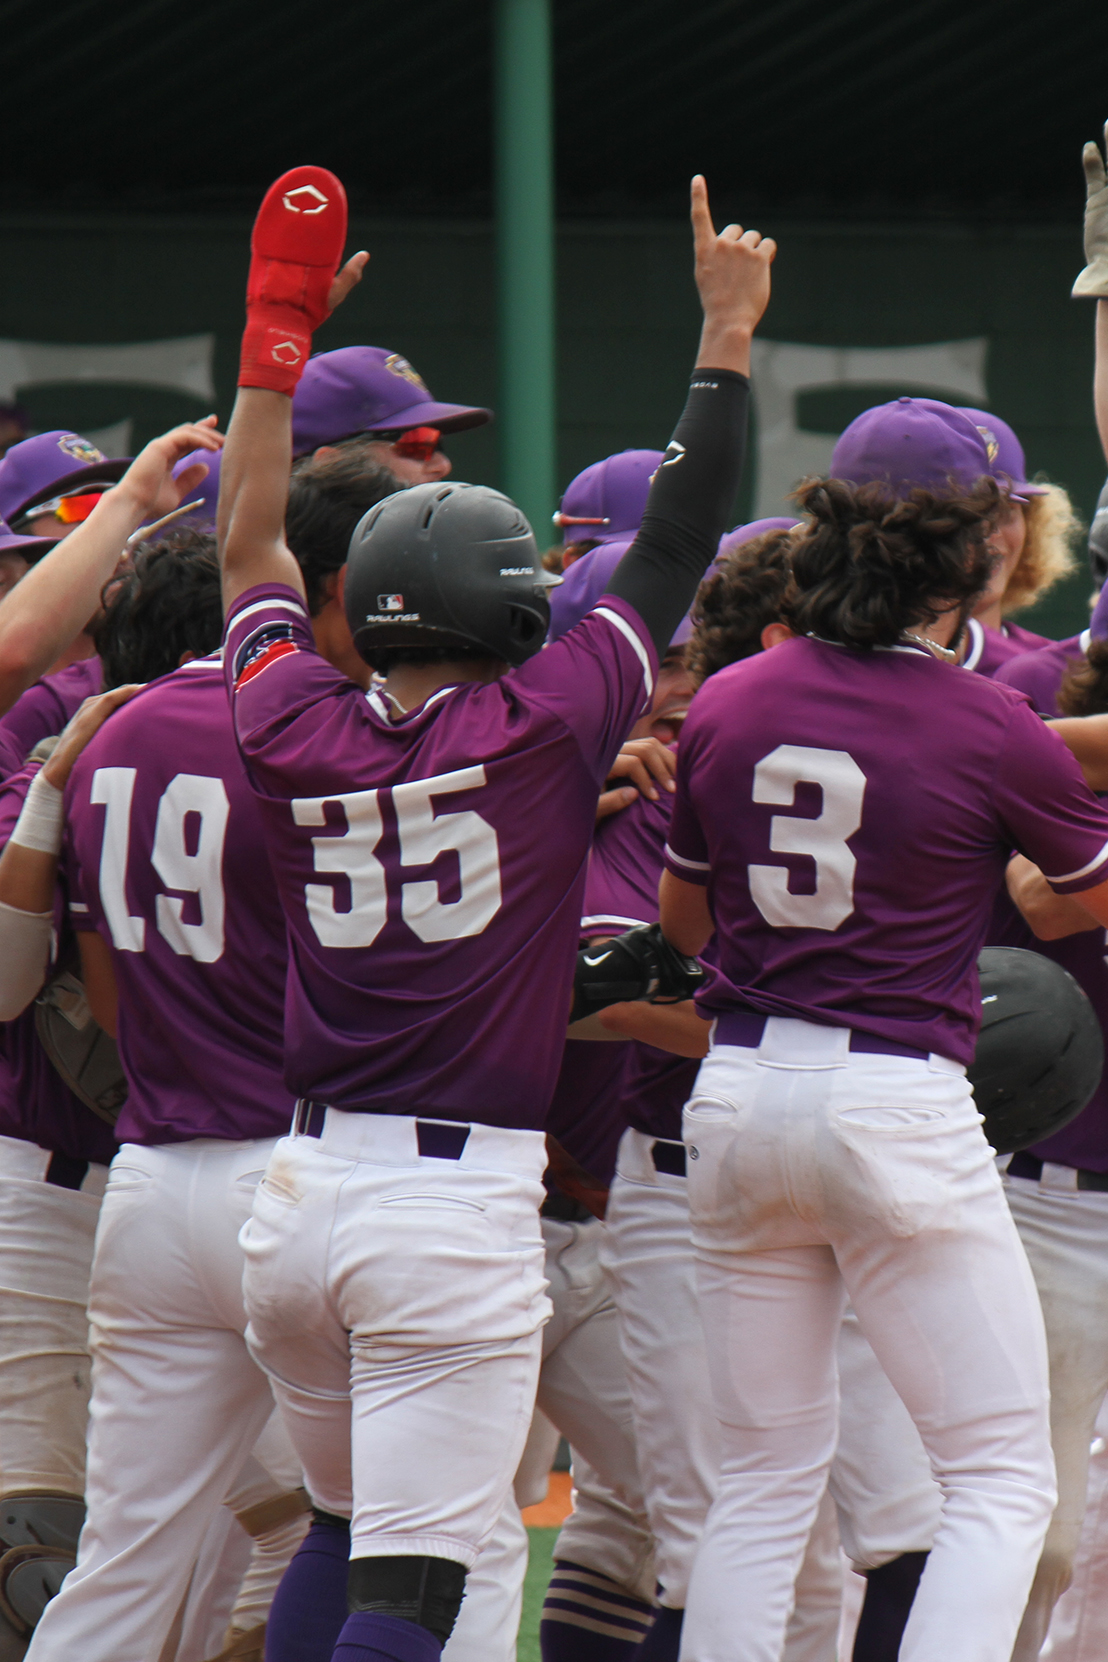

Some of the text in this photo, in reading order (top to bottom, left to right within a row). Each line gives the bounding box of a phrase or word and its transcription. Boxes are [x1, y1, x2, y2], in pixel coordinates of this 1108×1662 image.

[90, 766, 231, 963] 19
[291, 763, 502, 948] 35
[747, 743, 868, 932] 3
